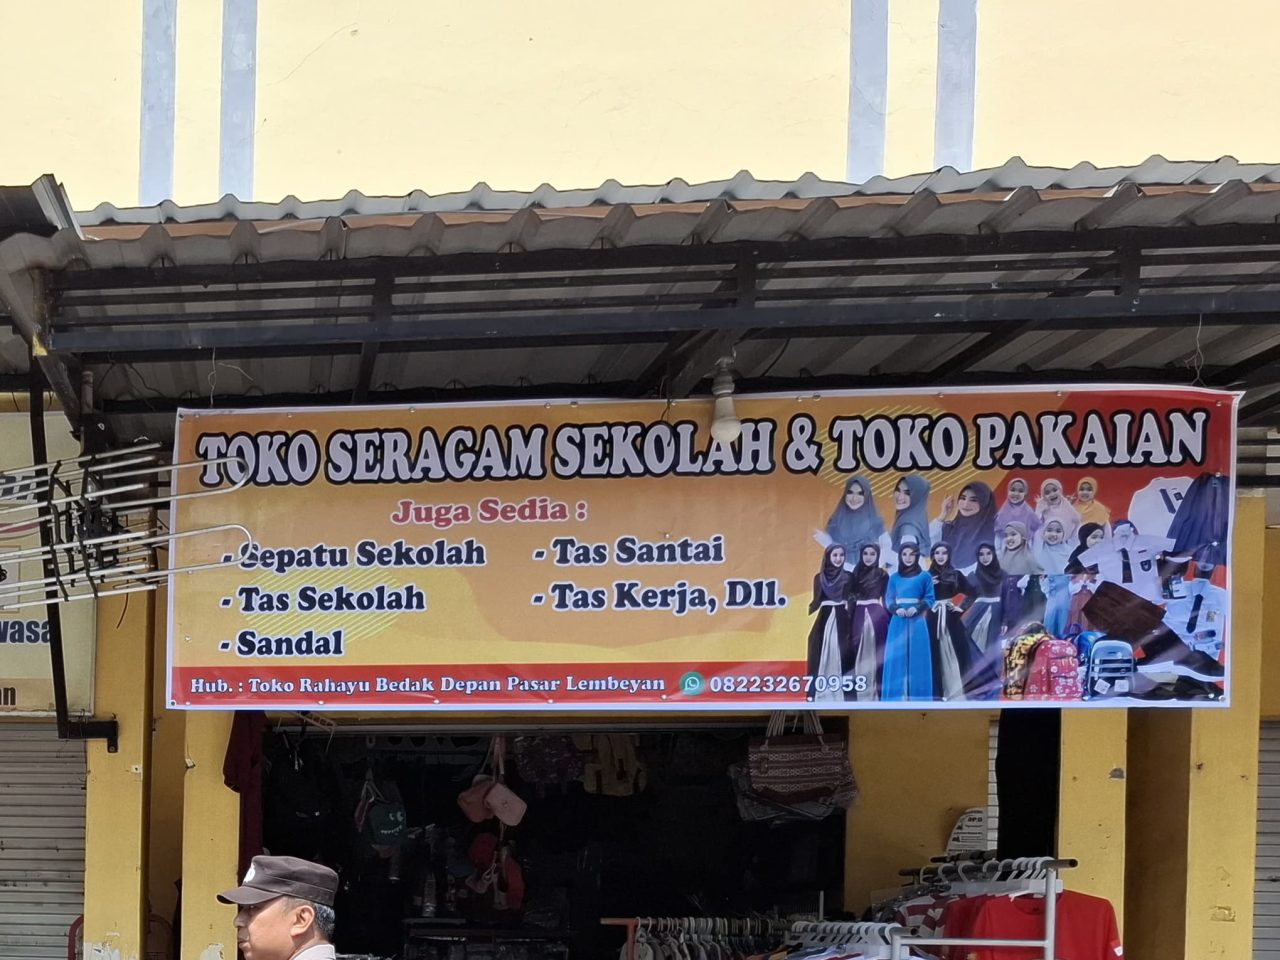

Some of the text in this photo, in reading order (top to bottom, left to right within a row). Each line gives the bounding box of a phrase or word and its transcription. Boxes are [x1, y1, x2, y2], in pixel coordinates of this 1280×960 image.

[200, 410, 1207, 486] TOKO SERAGAM SEKOLAH & TOKO PAKAIAN
[391, 498, 569, 529] Juga Sedia
[240, 538, 486, 573] Sepatu Sekolah
[552, 535, 725, 566] Tas Santai
[238, 585, 426, 613] Tas Sekolah
[550, 583, 606, 610] Tas
[613, 582, 718, 615] Kerja,
[237, 631, 343, 657] Sandal
[190, 674, 868, 698] Hub. Toko Rahayu Bedak Depan Pasar Lembeyan 082232670958
